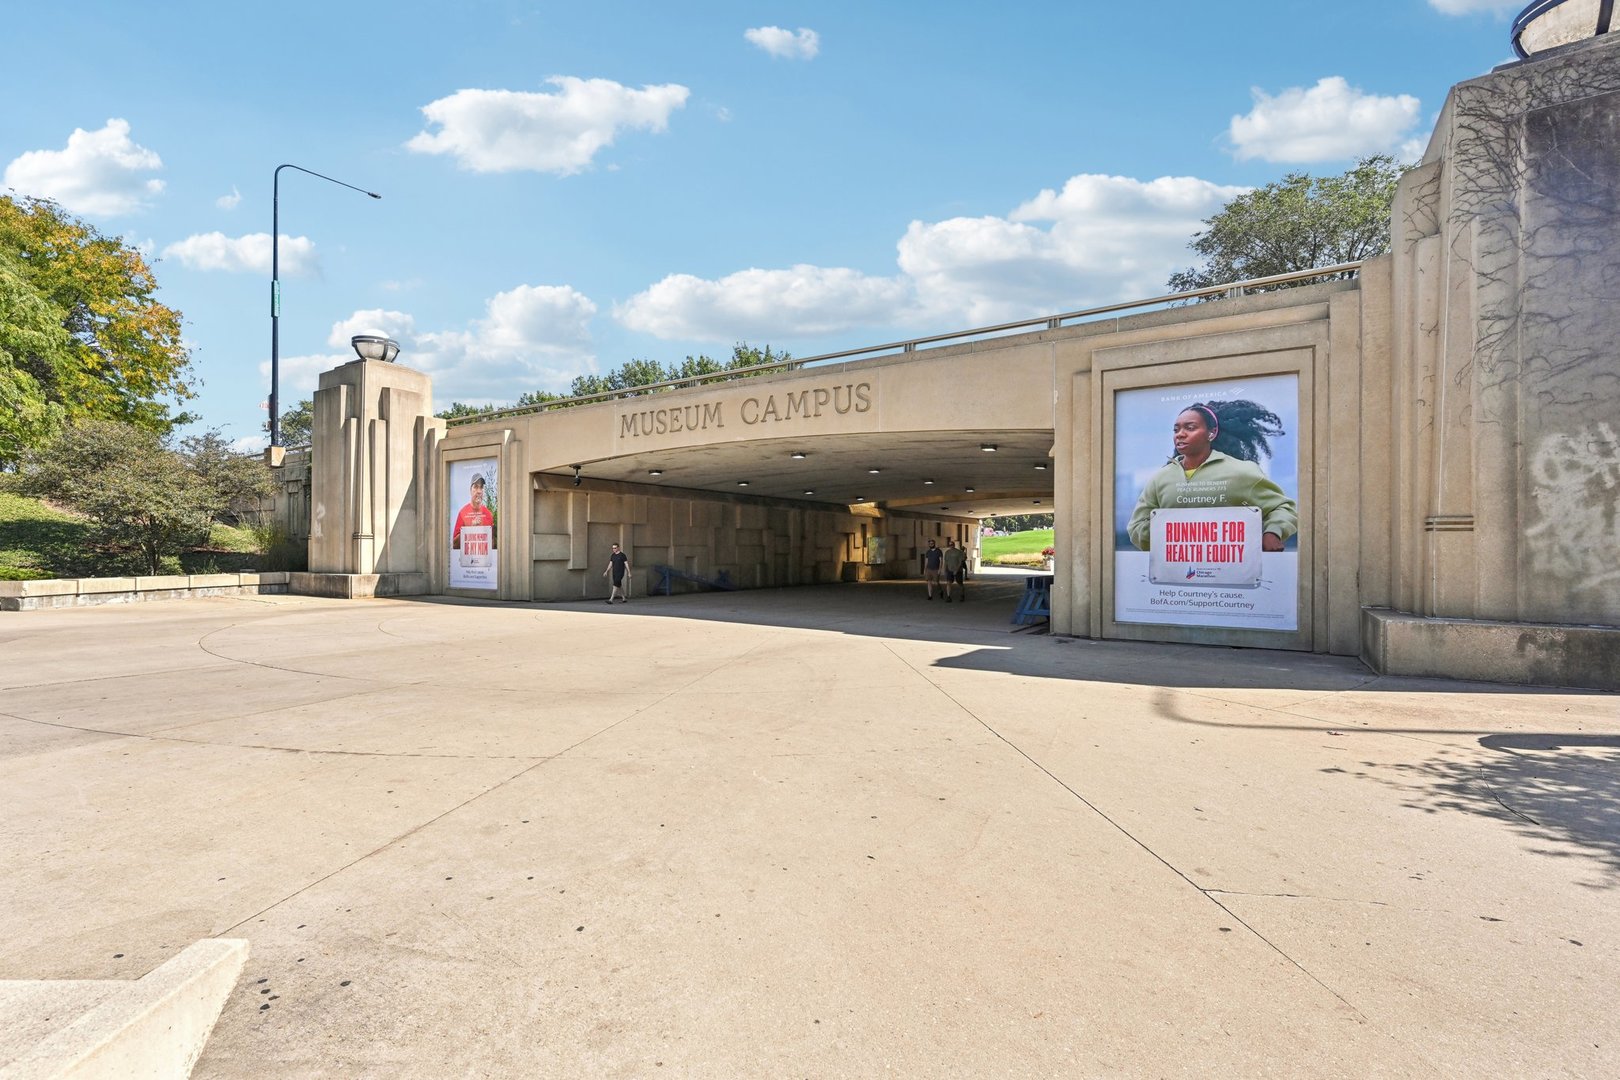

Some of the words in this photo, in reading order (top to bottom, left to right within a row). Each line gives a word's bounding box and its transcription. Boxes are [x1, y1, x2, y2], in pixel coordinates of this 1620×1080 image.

[1160, 394, 1181, 402] BANK
[1192, 391, 1227, 400] AMERICA
[619, 401, 725, 439] MUSEUM
[740, 382, 872, 425] CAMPUS
[1176, 495, 1217, 505] Courtney
[1219, 494, 1227, 502] F.
[1165, 521, 1218, 543] RUNNING
[1222, 521, 1245, 542] FOR
[1165, 544, 1203, 563] HEALTH
[1206, 543, 1245, 563] EQUITY
[1159, 590, 1176, 598] Help
[1178, 590, 1218, 599] Courtney's
[1150, 598, 1255, 610] BofA.com/SupportCourtney
